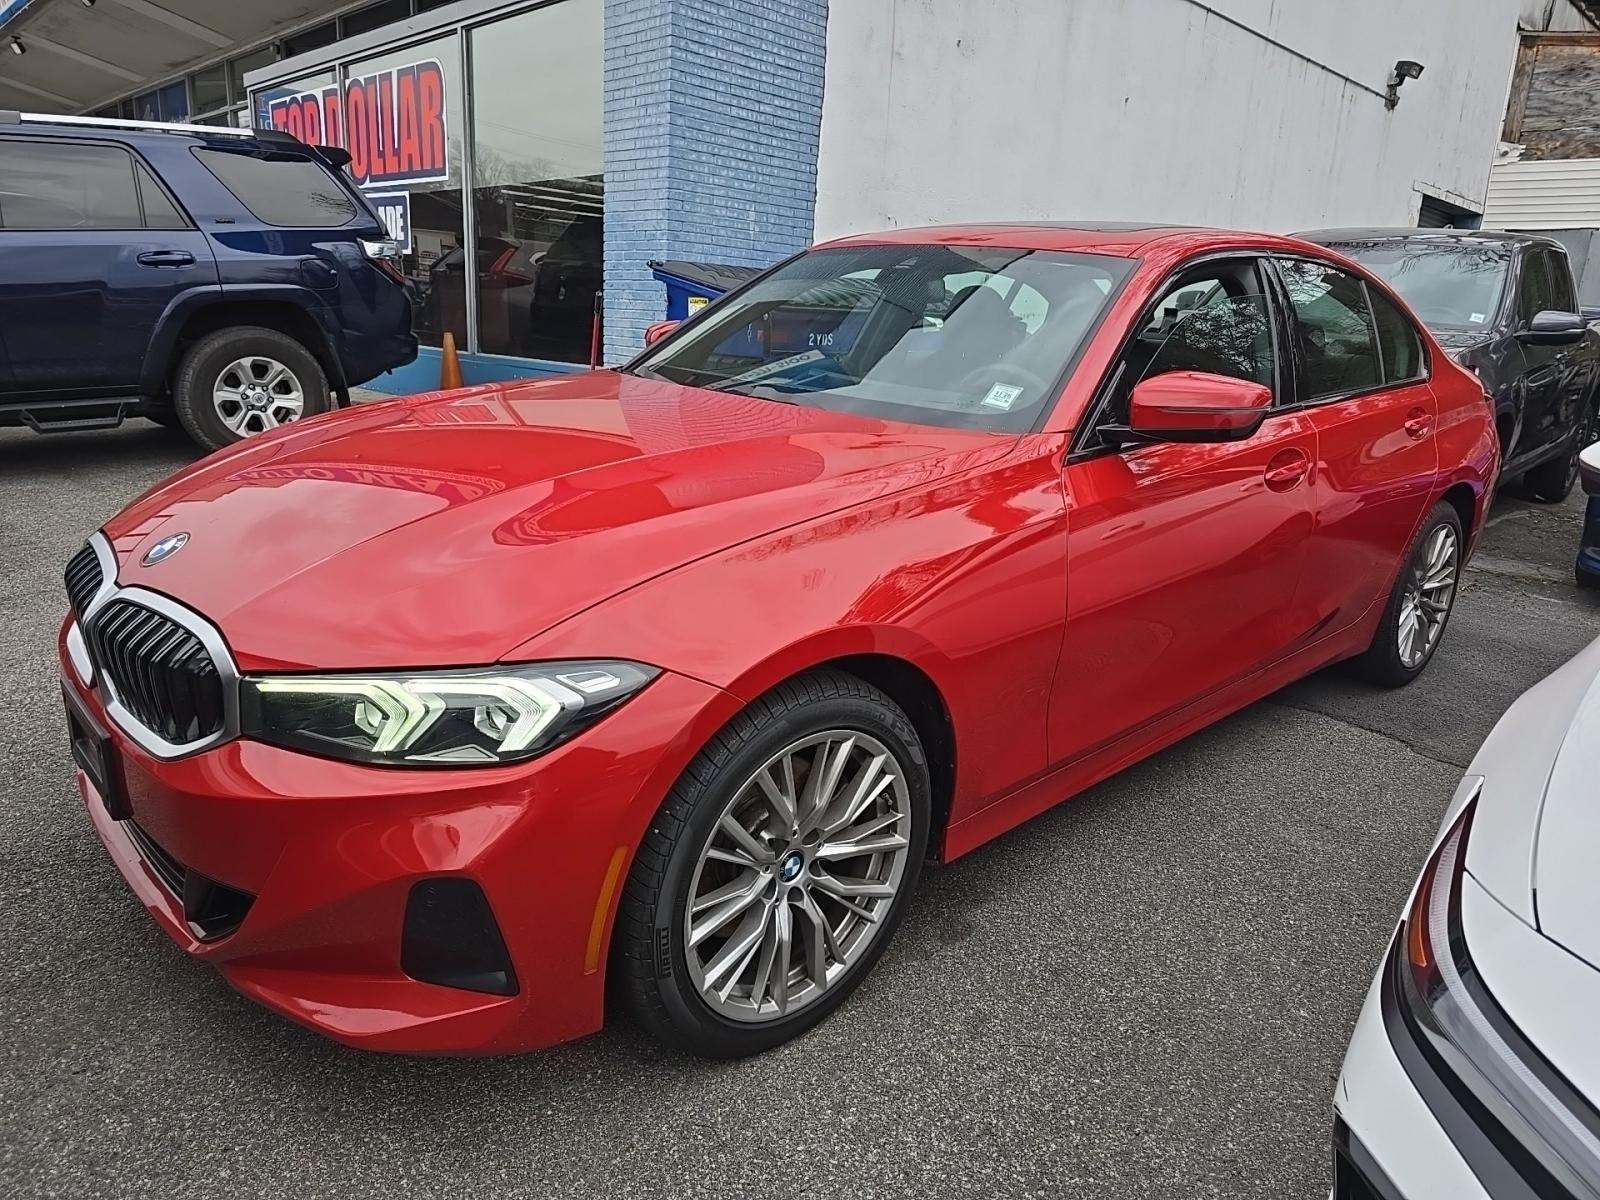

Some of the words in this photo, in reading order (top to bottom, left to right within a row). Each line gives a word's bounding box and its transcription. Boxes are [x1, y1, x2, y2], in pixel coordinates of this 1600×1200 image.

[272, 95, 320, 146] TOP
[324, 66, 443, 181] DOLLAR
[808, 333, 814, 346] 2
[816, 332, 834, 346] YDS
[657, 926, 672, 979] PIRELLI
